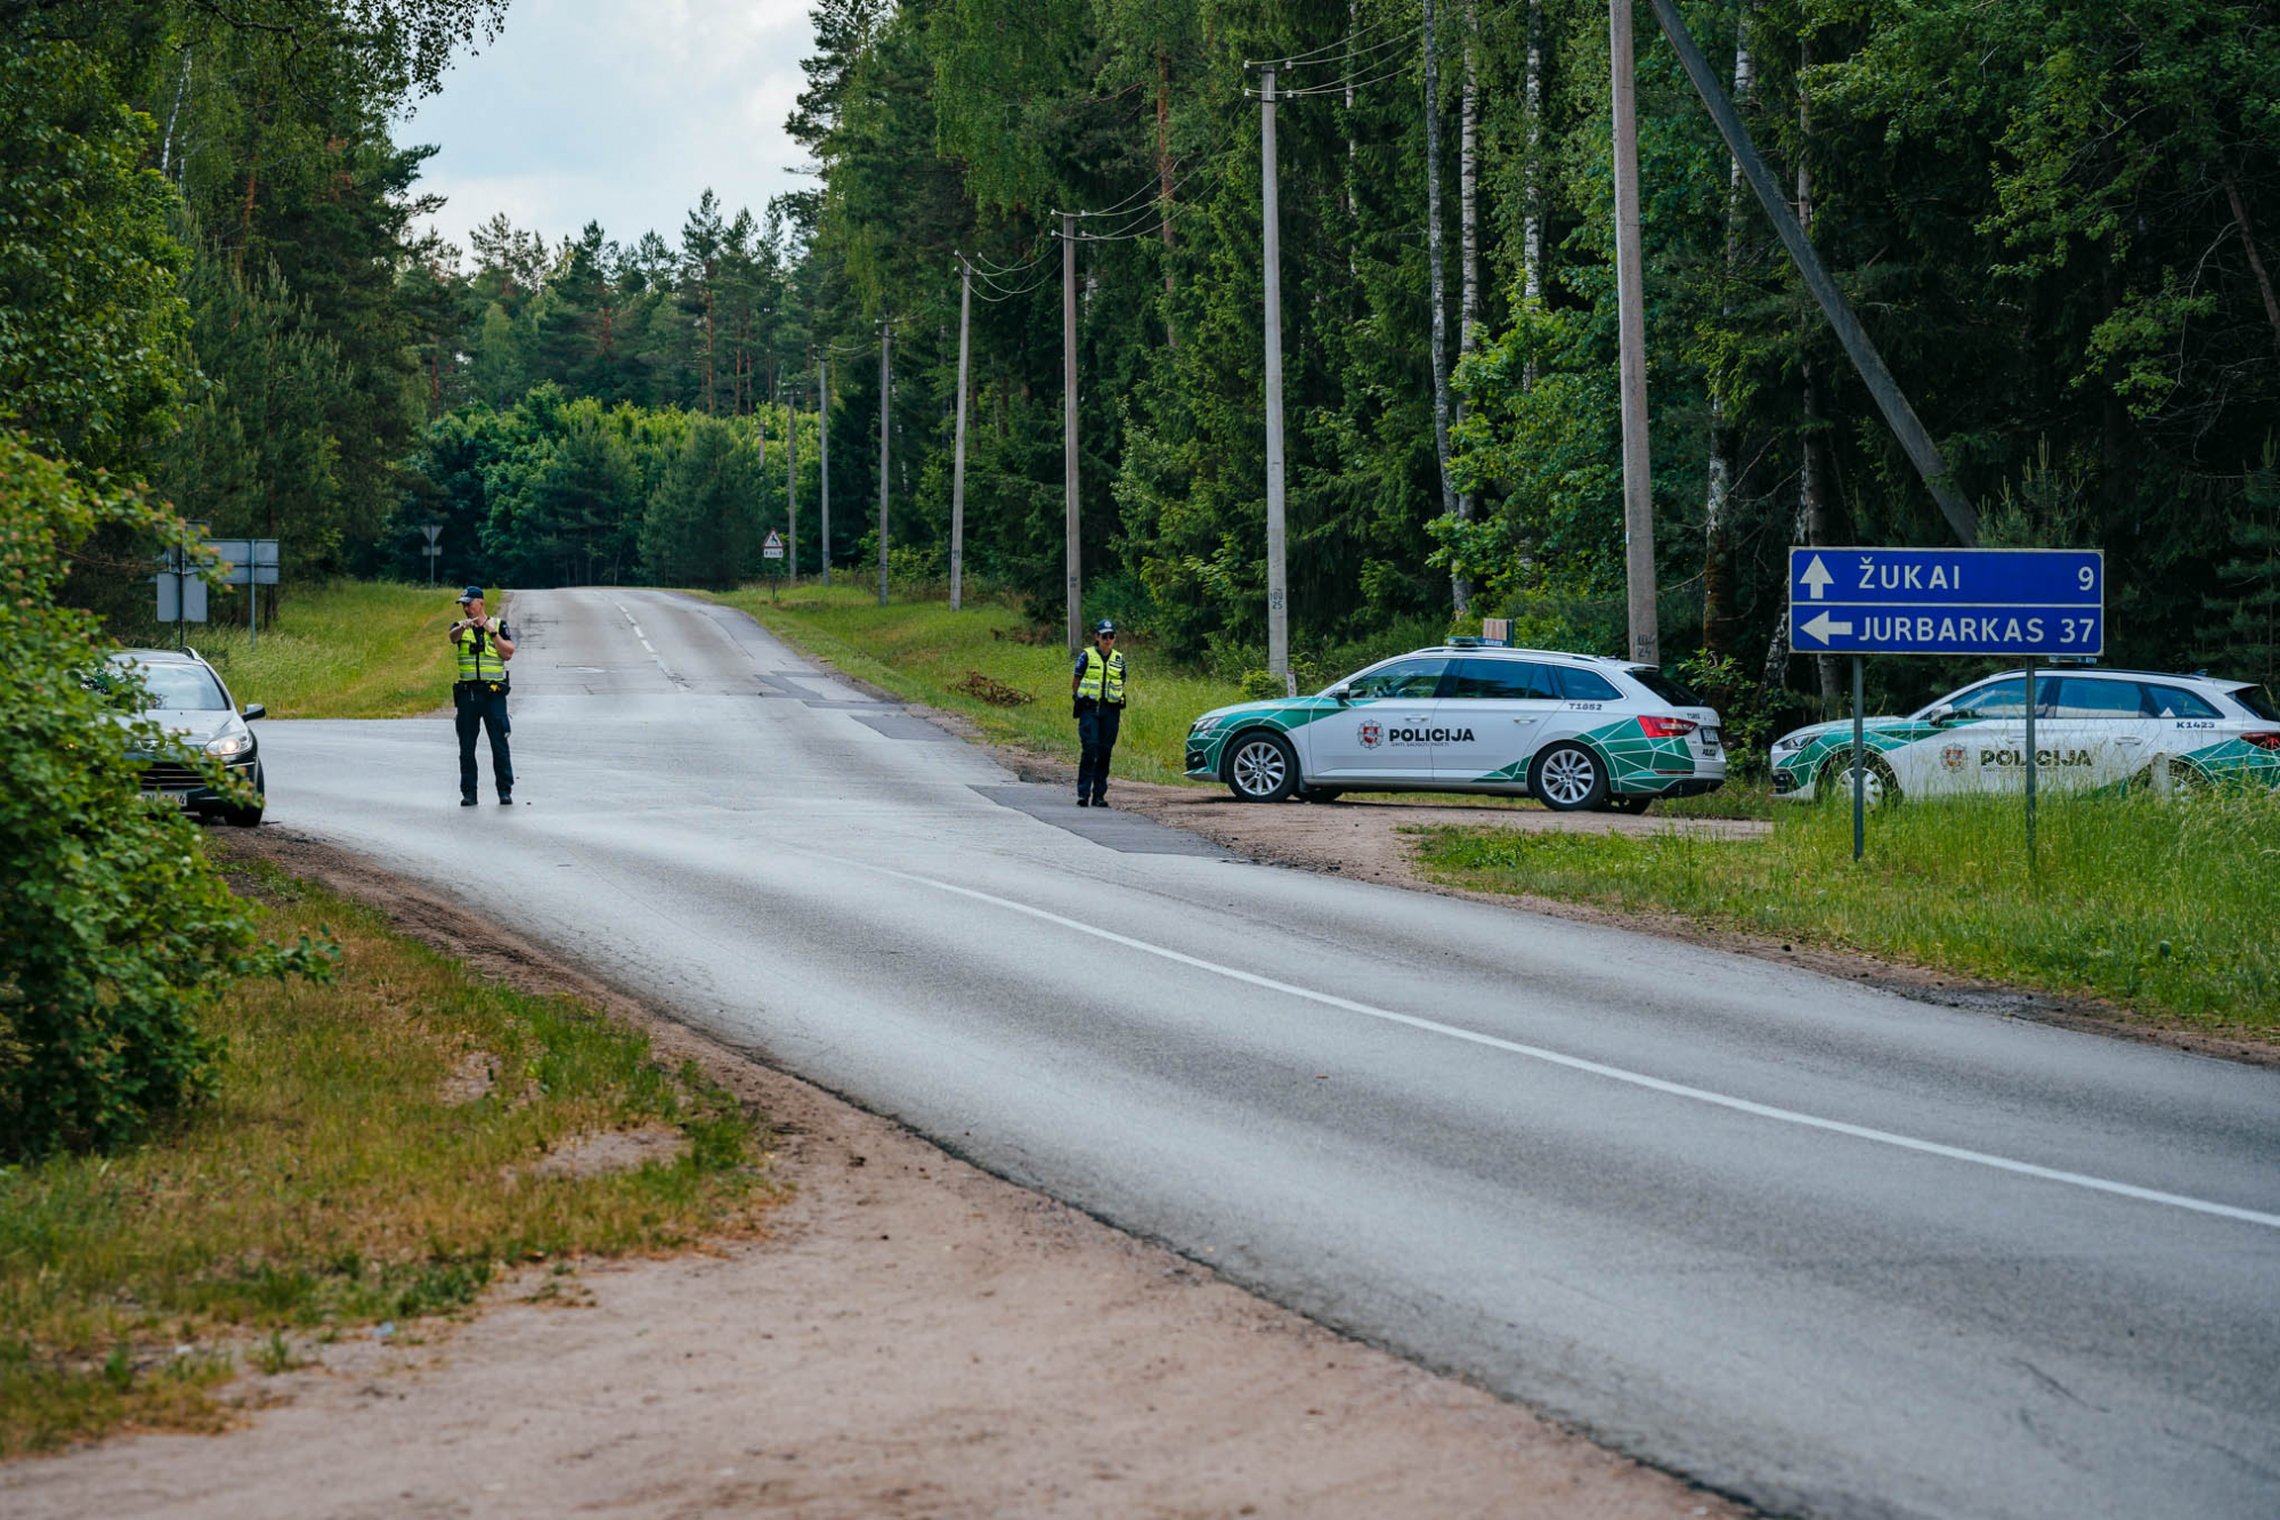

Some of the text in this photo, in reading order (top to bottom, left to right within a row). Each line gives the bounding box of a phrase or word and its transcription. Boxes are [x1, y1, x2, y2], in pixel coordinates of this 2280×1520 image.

[1858, 556, 2094, 591] ŽUKAI 9
[1858, 617, 2095, 643] JURBARKAS 37
[2176, 721, 2215, 729] K1423
[1389, 728, 1475, 742] POLICIJA
[1980, 749, 2093, 767] POLCIJA
